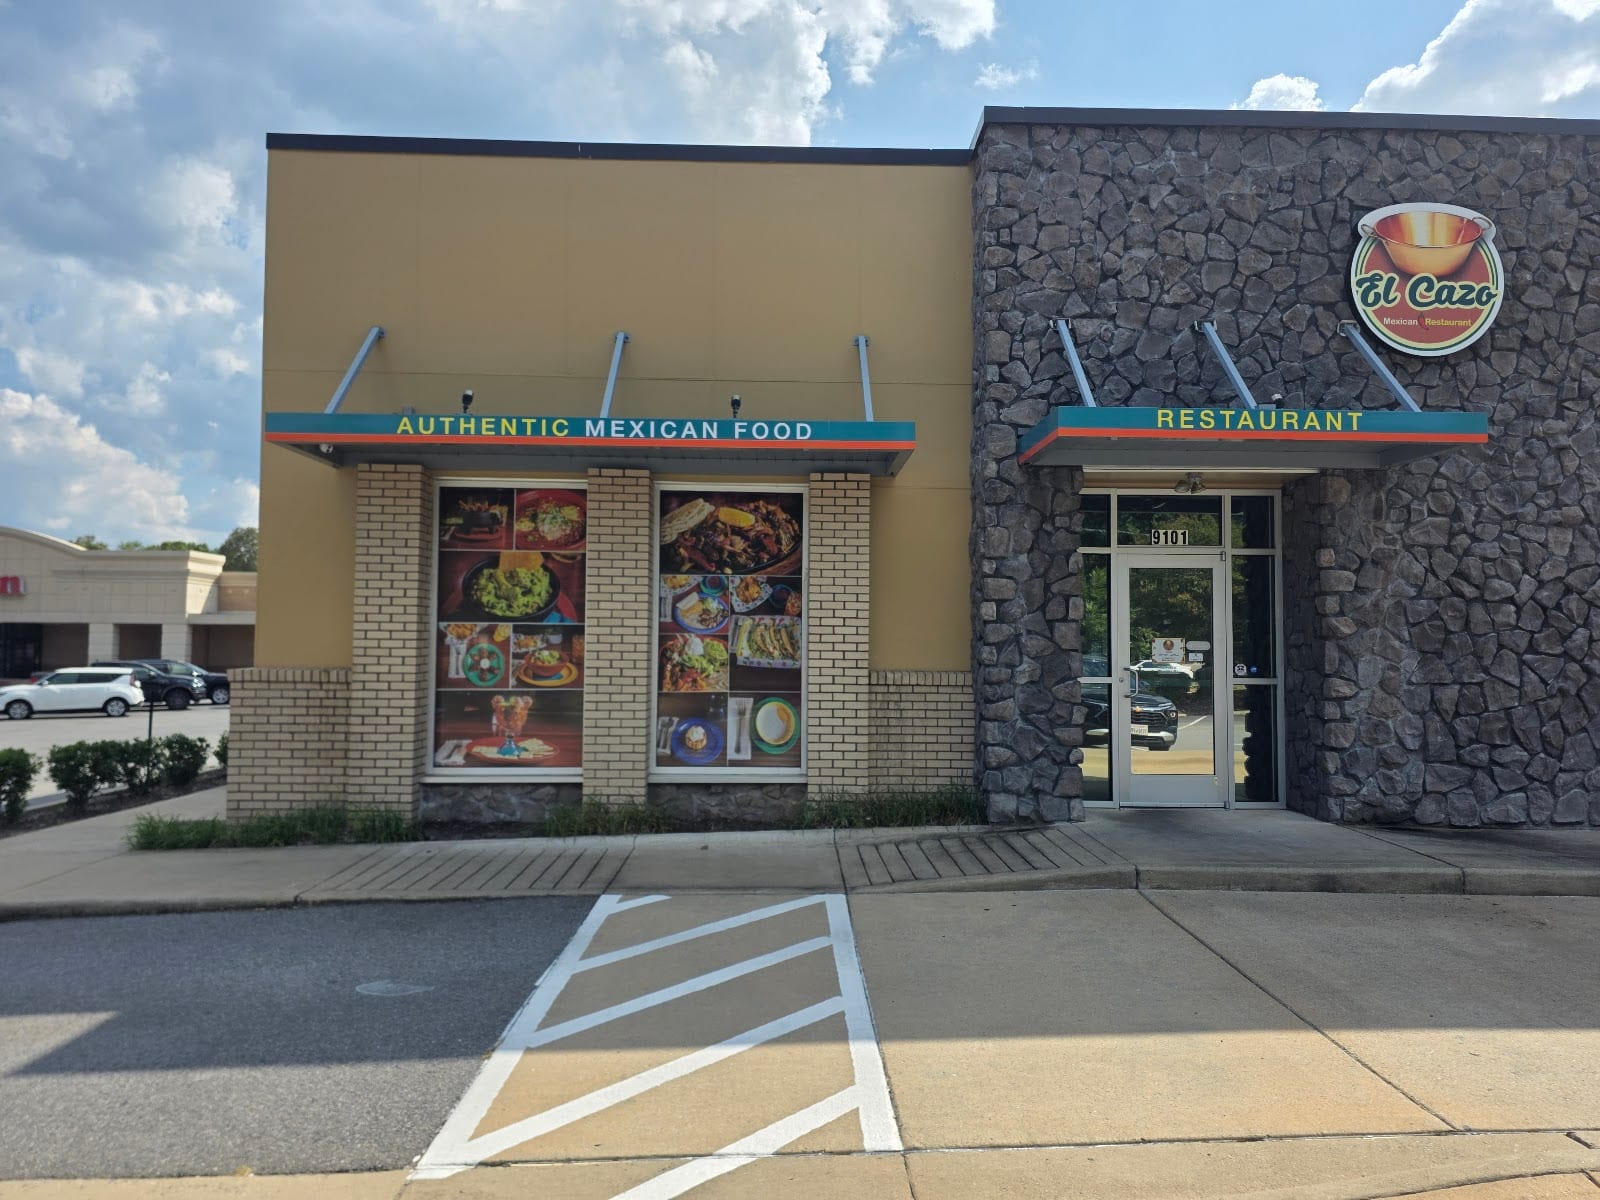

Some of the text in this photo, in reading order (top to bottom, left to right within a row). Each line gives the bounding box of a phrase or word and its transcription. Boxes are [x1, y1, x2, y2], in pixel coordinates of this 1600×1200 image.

[1356, 272, 1498, 308] El Cazo
[1383, 317, 1472, 327] Mexican Restaurant
[396, 416, 812, 440] AUTHENTIC MEXICAN FOOD
[1156, 409, 1363, 431] RESTAURANT
[1152, 530, 1187, 545] 9101
